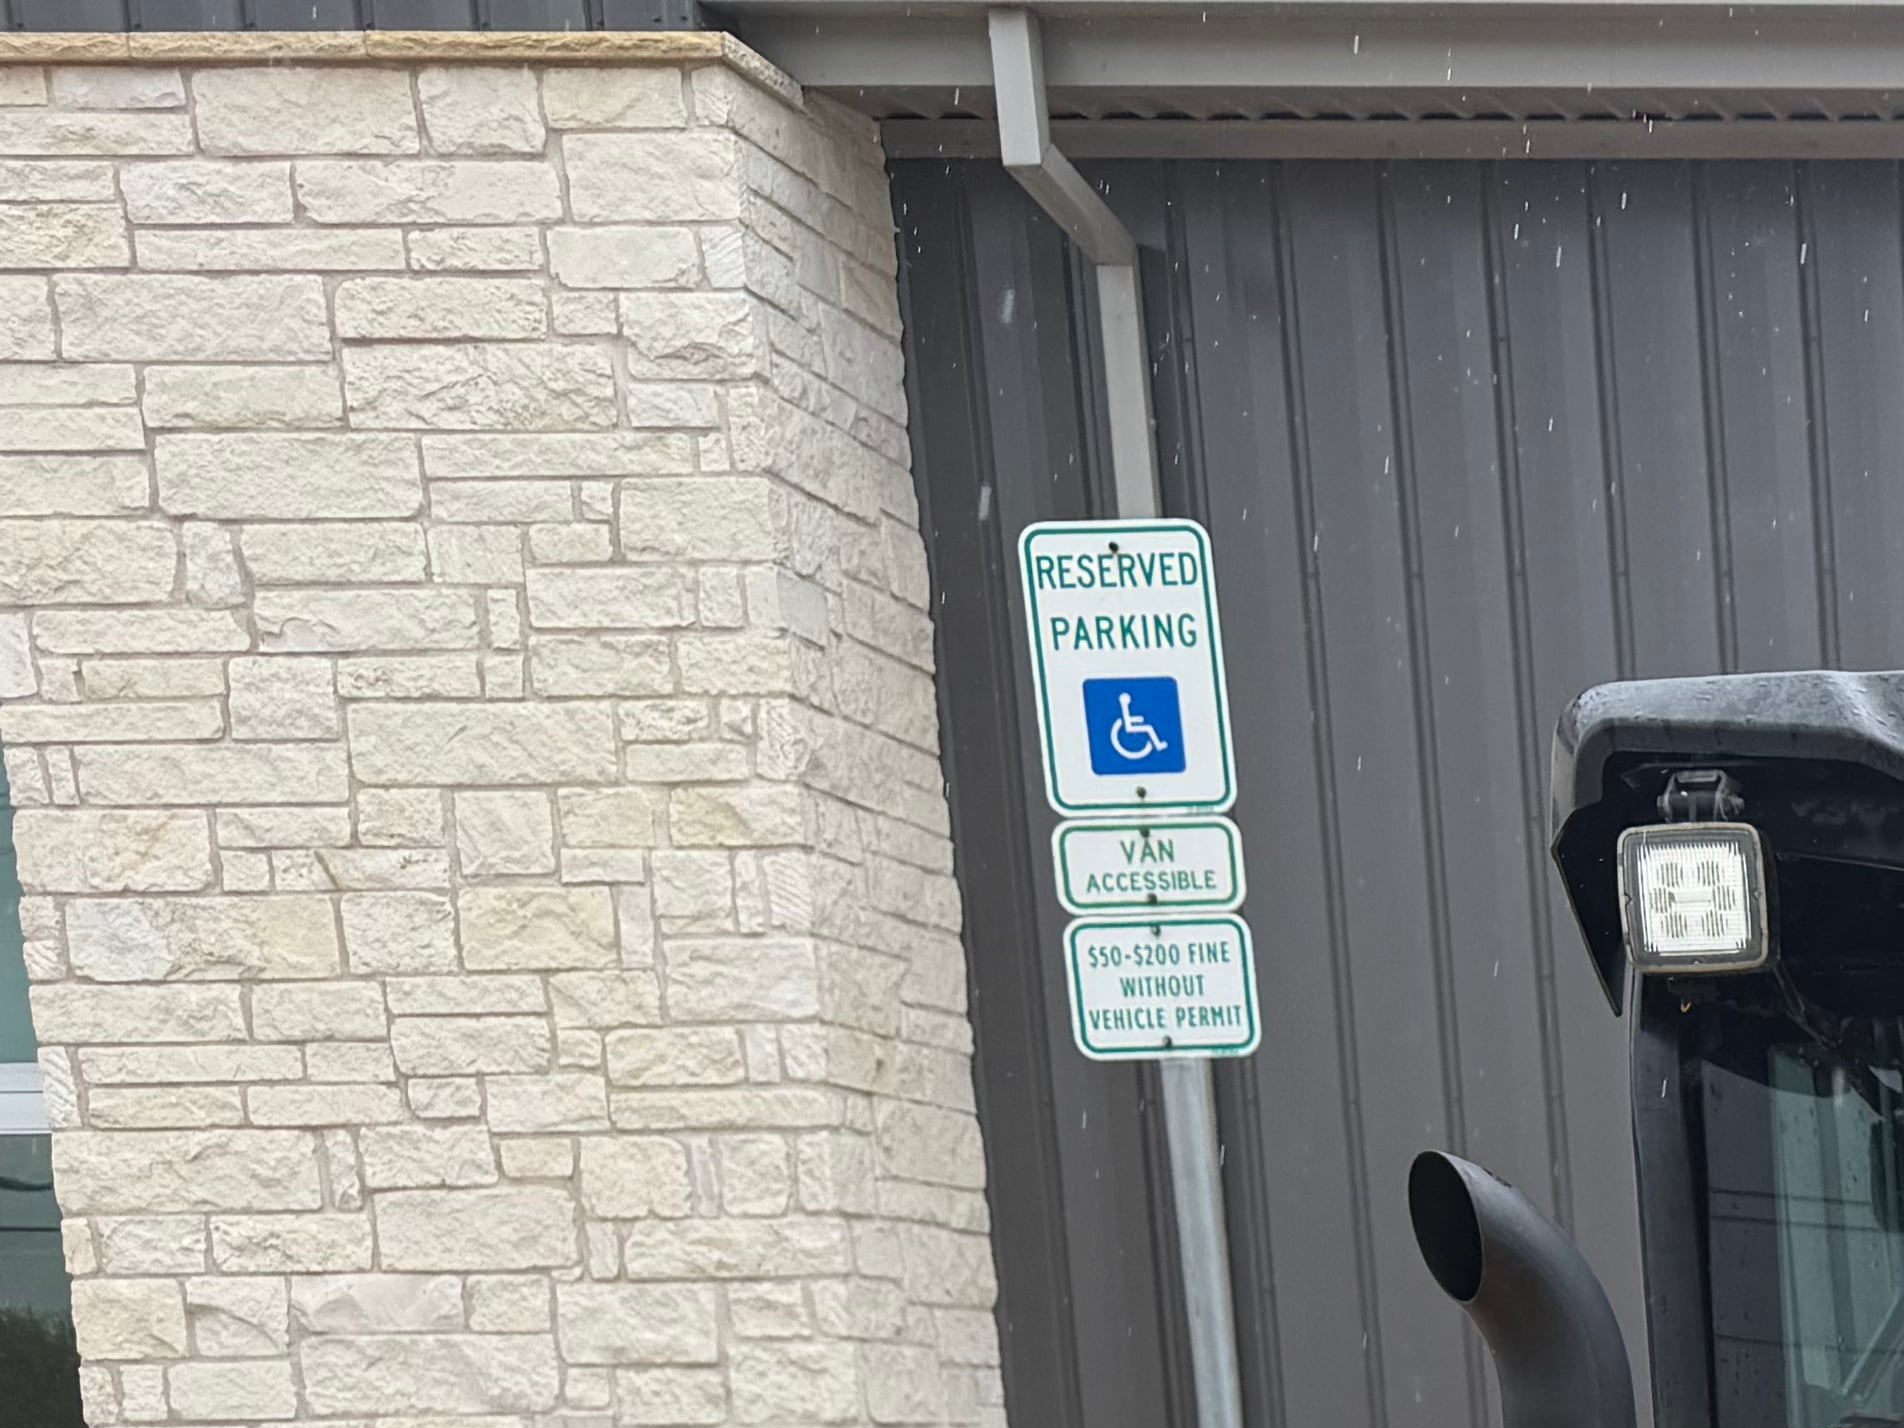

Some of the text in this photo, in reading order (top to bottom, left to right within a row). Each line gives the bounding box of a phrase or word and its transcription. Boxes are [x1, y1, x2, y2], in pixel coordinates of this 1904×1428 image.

[1038, 551, 1199, 590] RESERVED
[1051, 613, 1198, 651] PARKING
[1120, 839, 1175, 864] VAN
[1086, 870, 1217, 893] ACCESSIBLE
[1088, 940, 1231, 968] $50-$200 FINE
[1119, 974, 1206, 998] WITHOUT
[1088, 1004, 1242, 1031] VEHICLE PERMIT
